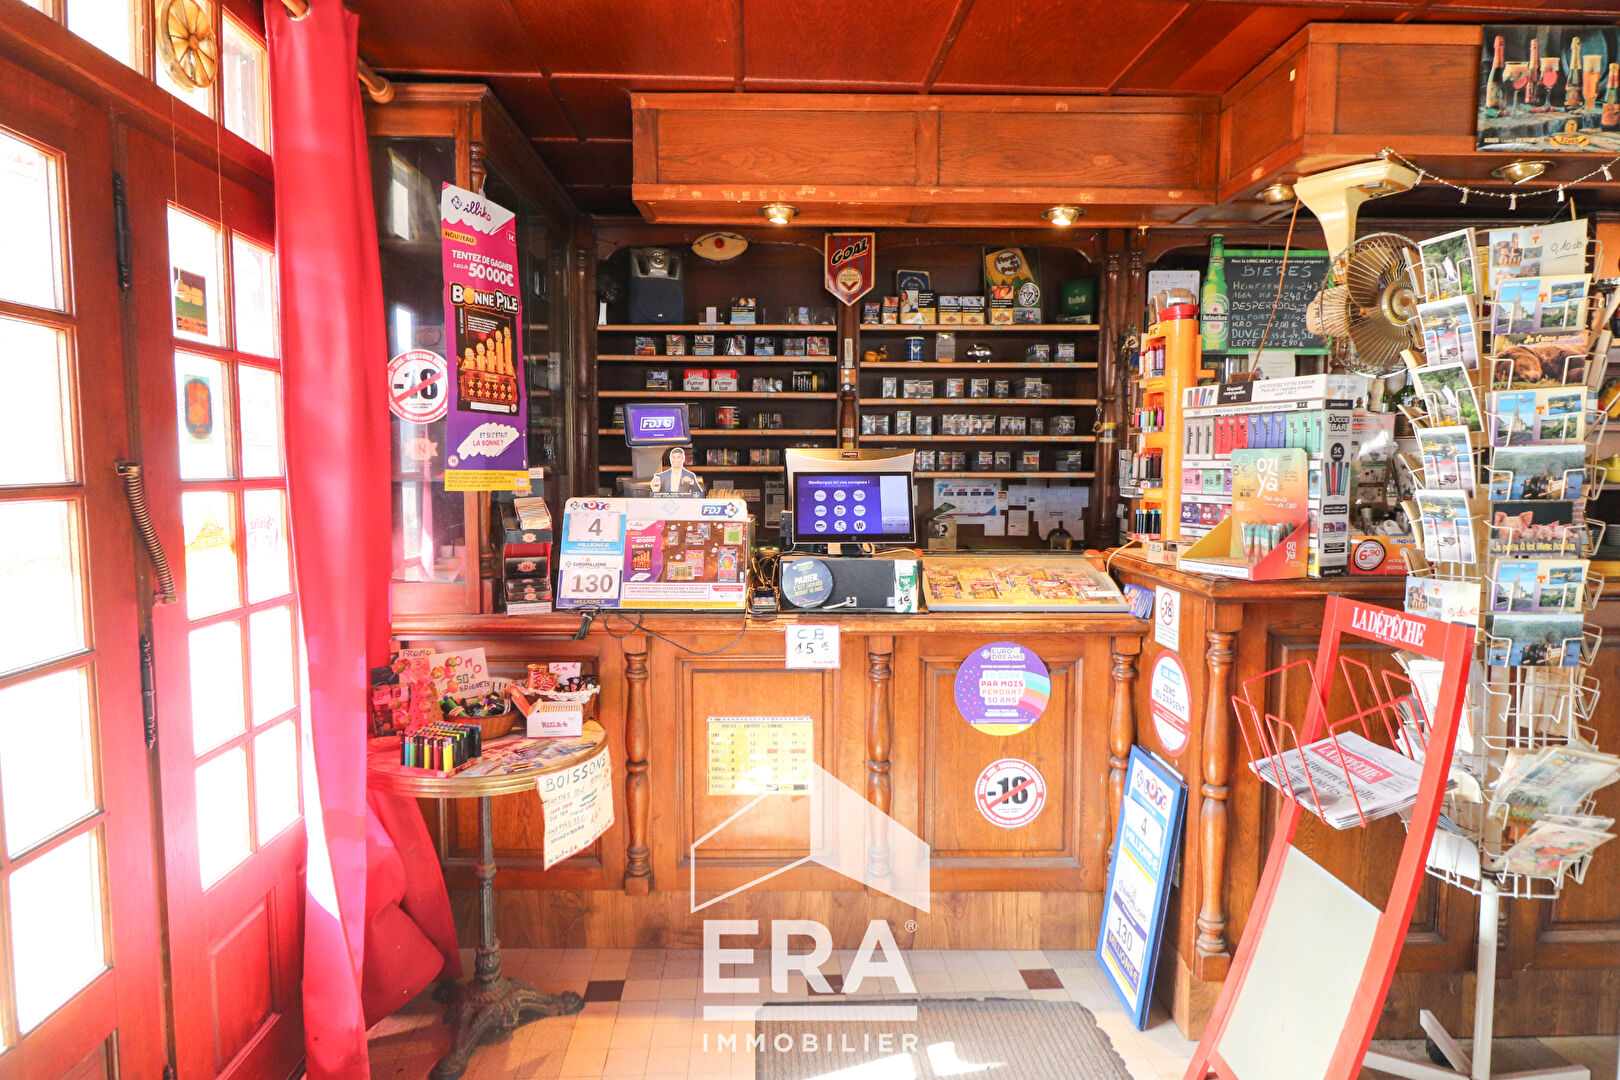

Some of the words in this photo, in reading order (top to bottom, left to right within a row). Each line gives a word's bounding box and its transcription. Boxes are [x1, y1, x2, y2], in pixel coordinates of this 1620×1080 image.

[462, 201, 492, 222] illiko
[444, 231, 474, 244] NOUVEAU
[452, 250, 481, 262] TENTEZ
[482, 256, 490, 266] DE
[490, 258, 513, 271] GAGNER
[831, 237, 869, 265] GOAL
[1240, 265, 1312, 278] BIERES
[496, 290, 519, 312] PILE
[1232, 329, 1265, 339] DUVEL
[642, 419, 662, 428] FDJ
[703, 506, 722, 515] FDJ
[588, 518, 602, 536] 4
[571, 574, 613, 593] 130
[797, 629, 824, 640] CB
[1352, 607, 1368, 630] LA
[1368, 610, 1426, 647] DÉPÊCHE
[794, 642, 815, 654] 15
[545, 753, 605, 792] BOISSONS
[987, 776, 1028, 804] -18
[1141, 818, 1147, 836] 4
[1116, 918, 1132, 952] 130
[1109, 932, 1134, 976] MILLIONS
